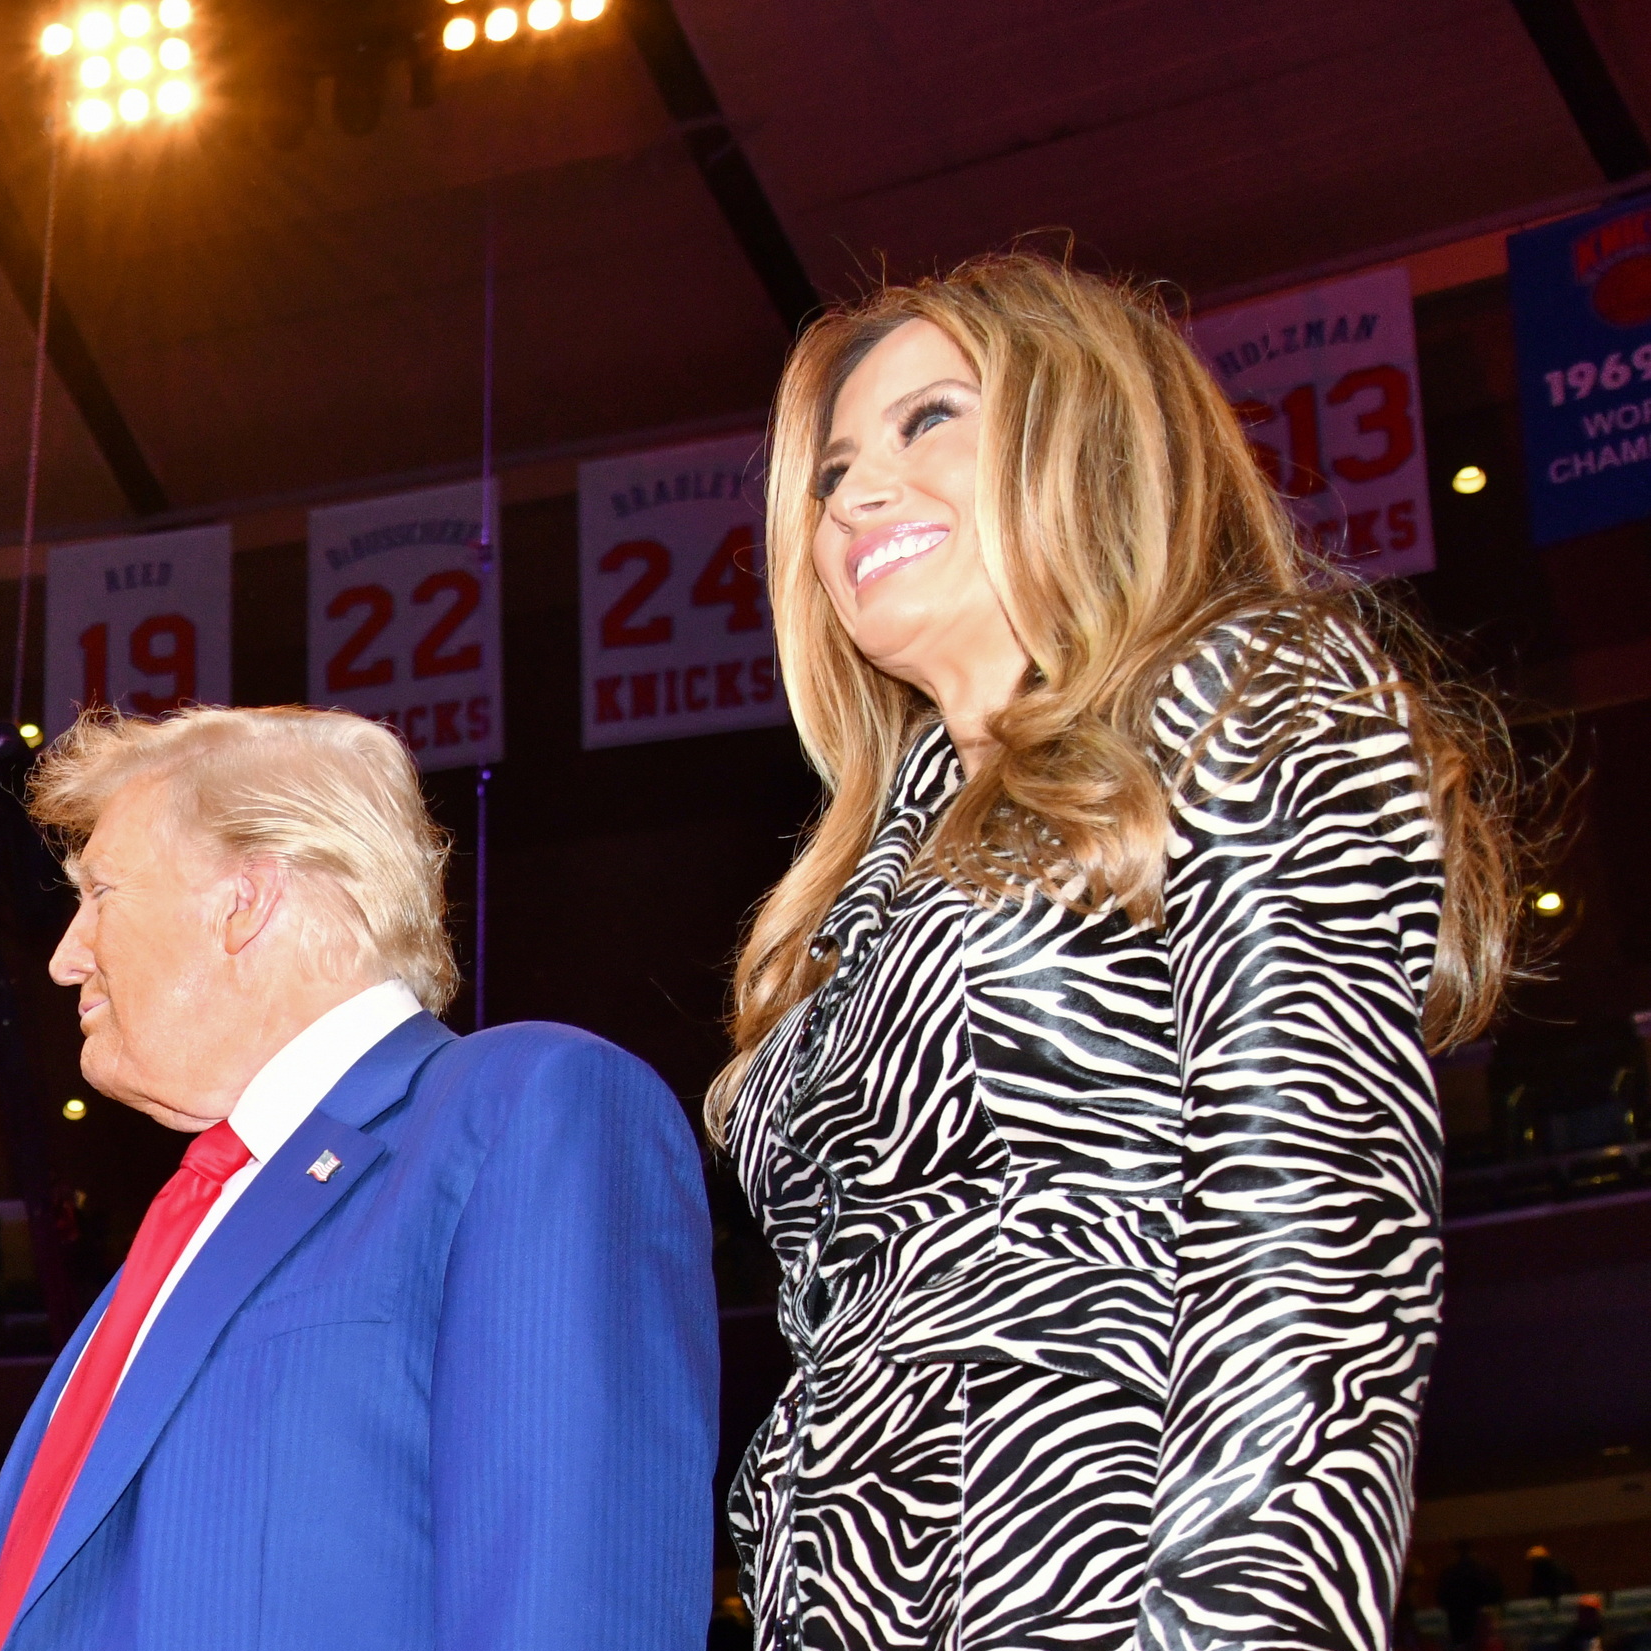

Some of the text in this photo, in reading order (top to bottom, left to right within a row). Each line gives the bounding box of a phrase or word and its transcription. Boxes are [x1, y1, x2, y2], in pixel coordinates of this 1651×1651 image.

[1216, 314, 1379, 378] HOLZMAN
[105, 563, 173, 592] REED
[600, 524, 763, 647] 24
[79, 615, 196, 718] 19
[327, 569, 481, 692] 22
[594, 657, 775, 723] KNICKS
